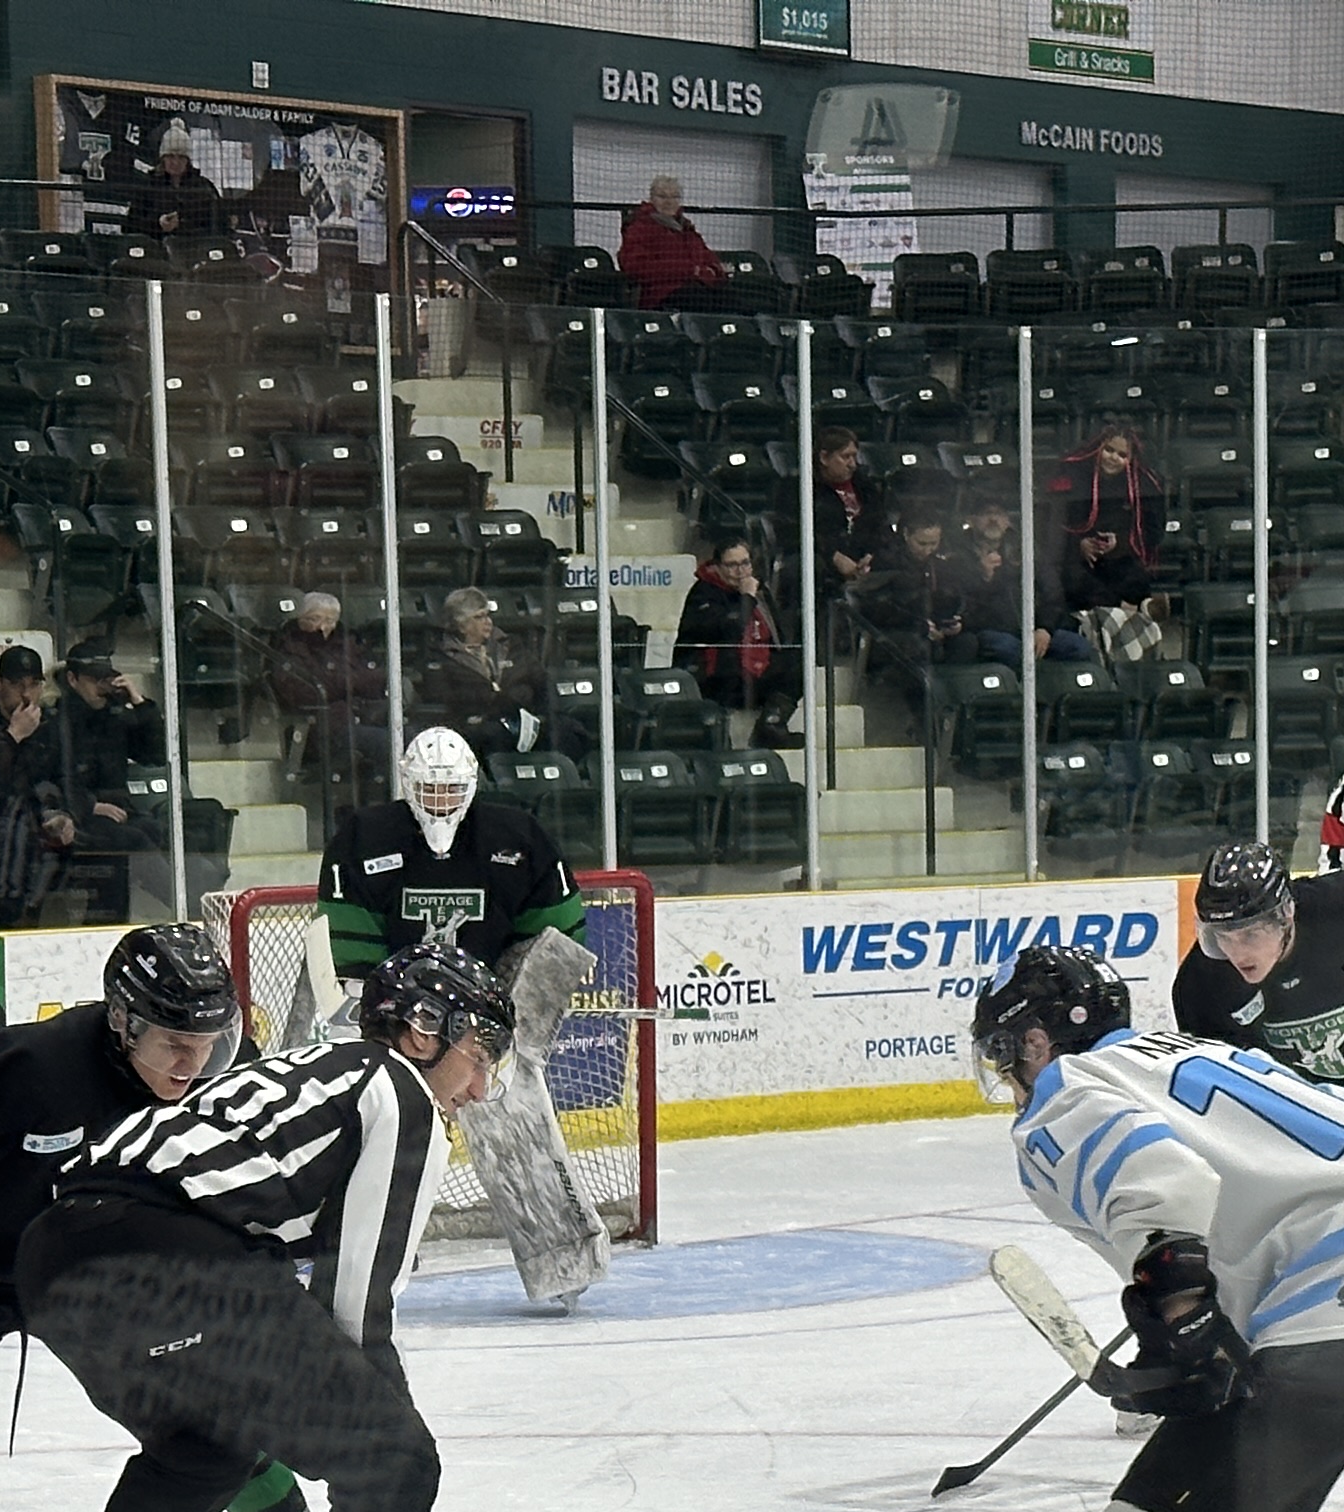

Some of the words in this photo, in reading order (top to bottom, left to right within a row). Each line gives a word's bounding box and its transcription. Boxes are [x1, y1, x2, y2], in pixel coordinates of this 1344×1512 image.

[1054, 47, 1076, 69] Grill
[1078, 50, 1089, 68] &
[1091, 52, 1131, 76] Snacks
[602, 66, 659, 106] BAR
[672, 75, 763, 117] SALES
[144, 97, 187, 113] FRIENDS
[188, 100, 202, 114] OF
[203, 102, 232, 117] ADAM
[234, 106, 272, 121] CALDER
[282, 110, 315, 125] FAMILY
[1021, 121, 1095, 152] McCAIN
[1100, 128, 1164, 158] FOODS
[479, 420, 524, 435] CFY
[547, 490, 578, 519] MI
[565, 564, 673, 587] ortaeOnline
[331, 864, 344, 899] 1
[557, 861, 570, 897] 1
[408, 895, 474, 906] PORTAGE
[801, 911, 1160, 975] WESTWARD
[656, 978, 776, 1011] MICROTEL
[672, 1033, 688, 1046] BY
[693, 1028, 759, 1044] WYNDHAM
[865, 1034, 956, 1061] PORTAGE
[147, 1332, 203, 1358] CCM
